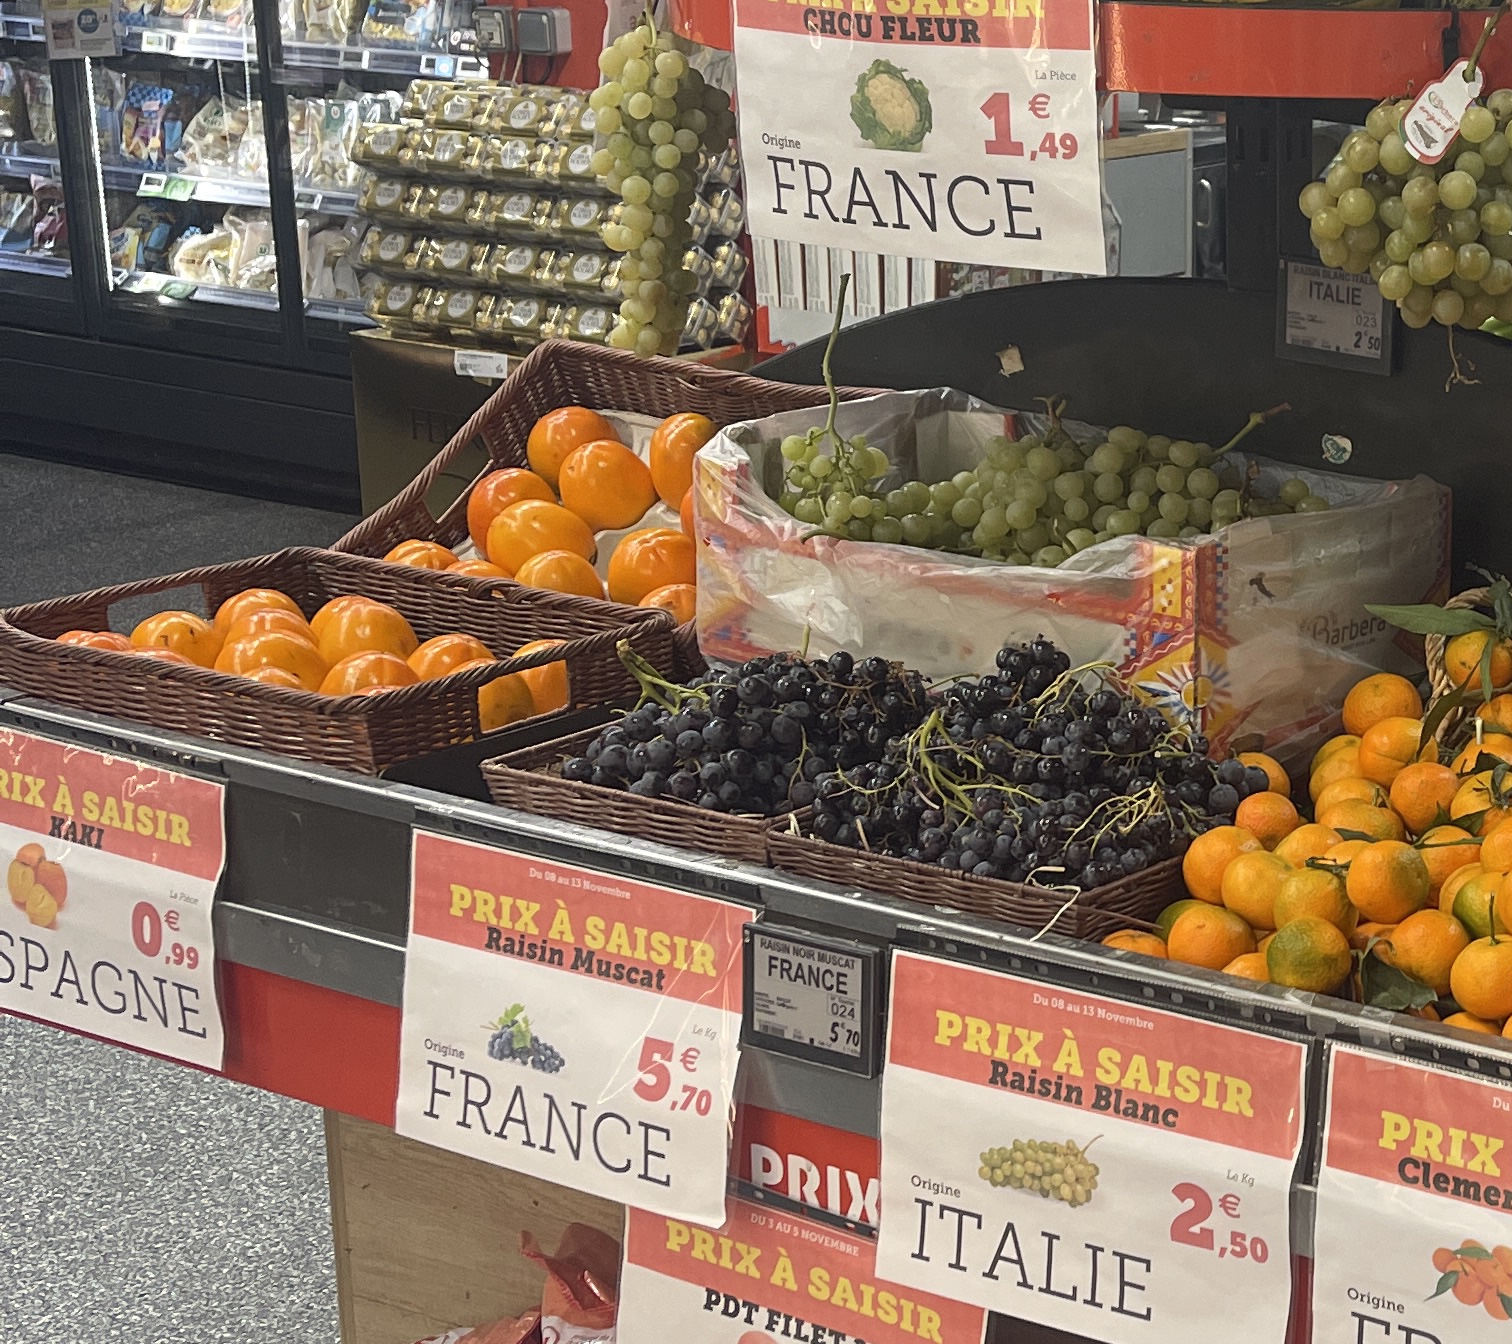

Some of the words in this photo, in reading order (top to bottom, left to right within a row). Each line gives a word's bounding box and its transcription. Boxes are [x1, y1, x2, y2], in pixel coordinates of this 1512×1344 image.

[803, 9, 873, 38] CHOU
[881, 15, 981, 44] FLEUR
[1035, 70, 1047, 81] La
[1050, 70, 1077, 82] Pièce
[762, 132, 801, 150] Origine
[767, 155, 1042, 240] FRANCE
[1309, 280, 1362, 306] ITALIE
[1356, 315, 1377, 328] 023
[1311, 611, 1386, 645] Barbera
[0, 770, 45, 808] RIX
[53, 776, 74, 816] À
[82, 791, 191, 847] SAISIR
[49, 816, 104, 850] KAKI
[528, 867, 543, 879] Du
[583, 879, 631, 900] Novembre
[449, 884, 539, 936] PRIX
[548, 900, 575, 944] À
[584, 916, 717, 977] SAISIR
[484, 926, 564, 966] Raisin
[570, 947, 666, 991] Muscat
[760, 937, 790, 955] RAISIN
[793, 945, 816, 962] NOIR
[817, 951, 855, 970] MUSCAT
[0, 930, 207, 1038] SPAGNE
[768, 955, 848, 995] FRANCE
[831, 1003, 855, 1019] 024
[1033, 992, 1048, 1005] Du
[1050, 997, 1064, 1009] 08
[1066, 1002, 1080, 1013] au
[1082, 1003, 1095, 1016] 13
[1097, 1006, 1154, 1030] Novembre
[424, 1038, 465, 1060] Origine
[934, 1009, 1043, 1067] PRIX
[1052, 1028, 1084, 1077] À
[1095, 1047, 1254, 1117] SAISIR
[988, 1060, 1084, 1106] Raisin
[1091, 1085, 1179, 1128] Blanc
[1491, 1097, 1511, 1111] Du
[423, 1060, 671, 1187] FRANCE
[1379, 1111, 1505, 1178] PRIX
[750, 1143, 881, 1225] PRIX
[911, 1175, 961, 1198] Origine
[1226, 1169, 1239, 1182] Le
[1241, 1174, 1255, 1188] Kg
[750, 1213, 765, 1225] DU
[775, 1220, 790, 1233] AU
[801, 1227, 860, 1257] NOVEMBRE
[911, 1197, 1151, 1321] ITALIE
[665, 1218, 761, 1280] PRIX
[769, 1247, 797, 1291] À
[807, 1267, 943, 1344] SAISIR
[702, 1287, 759, 1324] PDT
[1347, 1287, 1405, 1314] Origine
